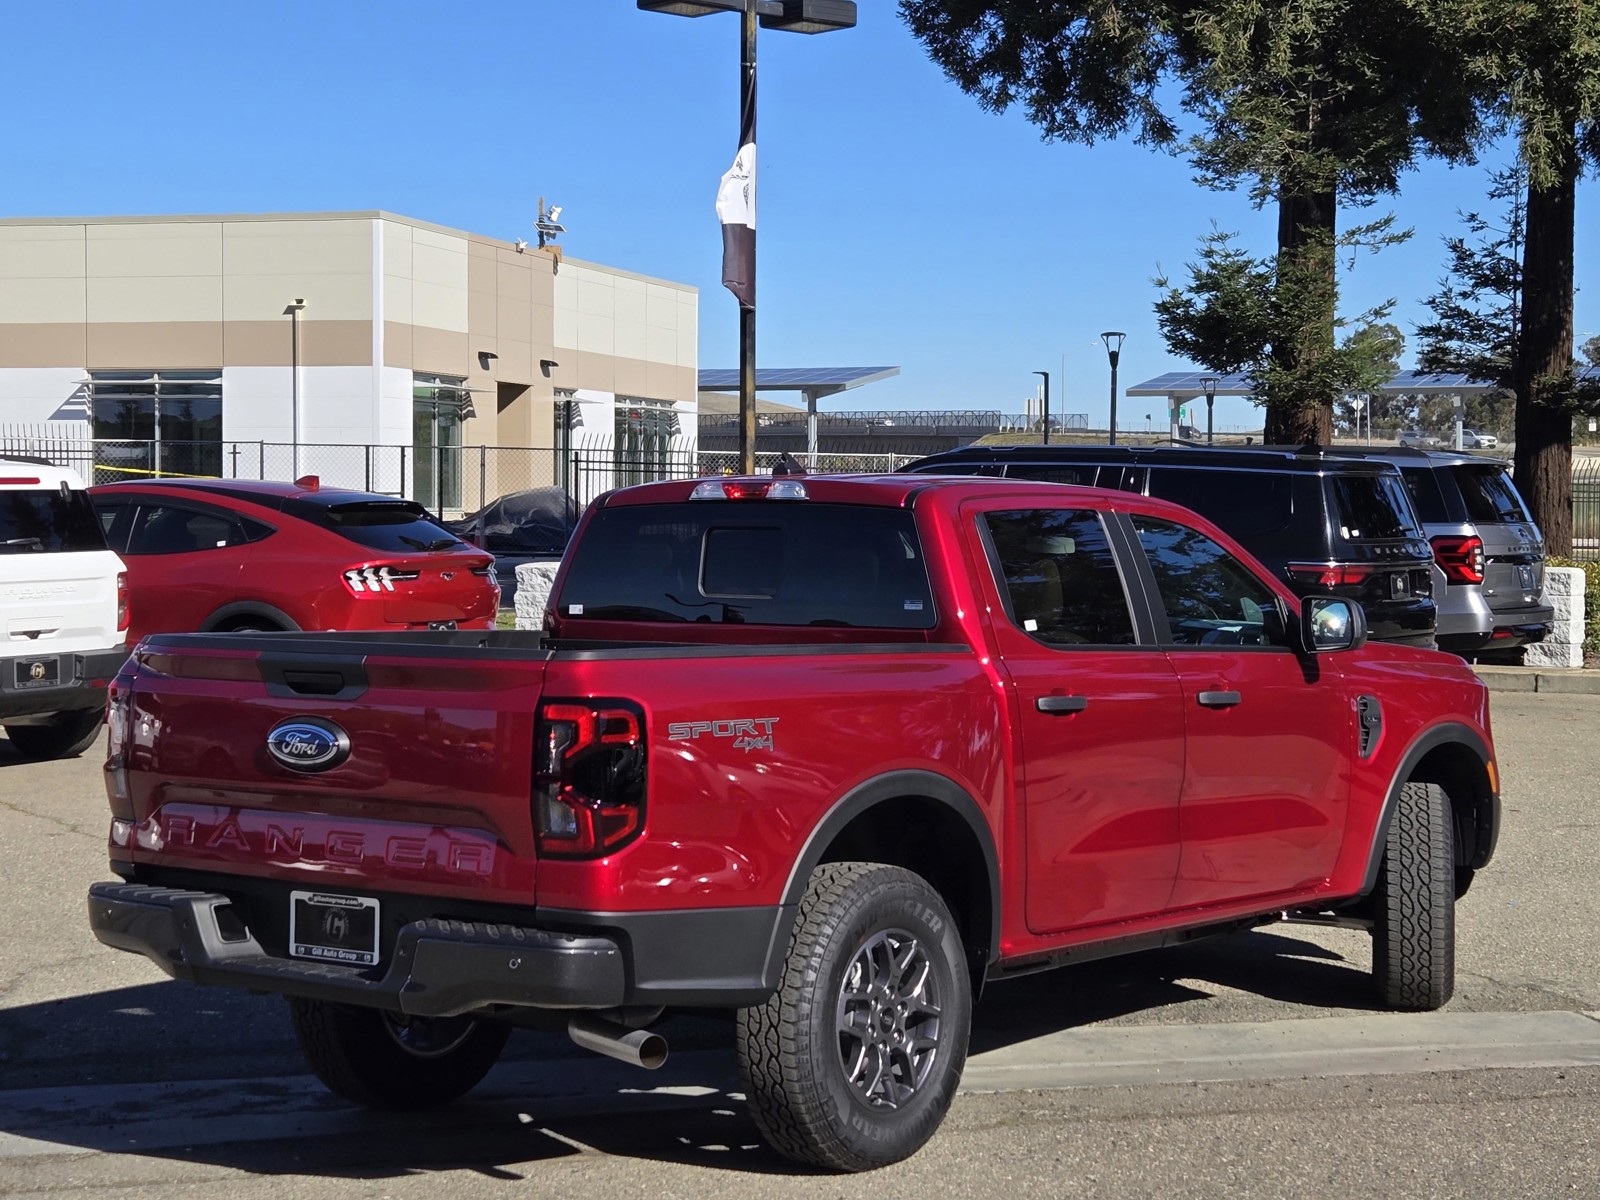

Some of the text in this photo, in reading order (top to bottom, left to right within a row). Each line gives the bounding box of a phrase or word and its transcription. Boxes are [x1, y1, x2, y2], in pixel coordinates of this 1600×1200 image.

[0, 587, 78, 596] RONCO
[668, 717, 780, 741] SPORT
[282, 731, 319, 755] Ford
[161, 812, 496, 877] RANGER
[312, 947, 323, 956] Gill
[322, 948, 338, 957] Auto
[338, 951, 356, 960] Group
